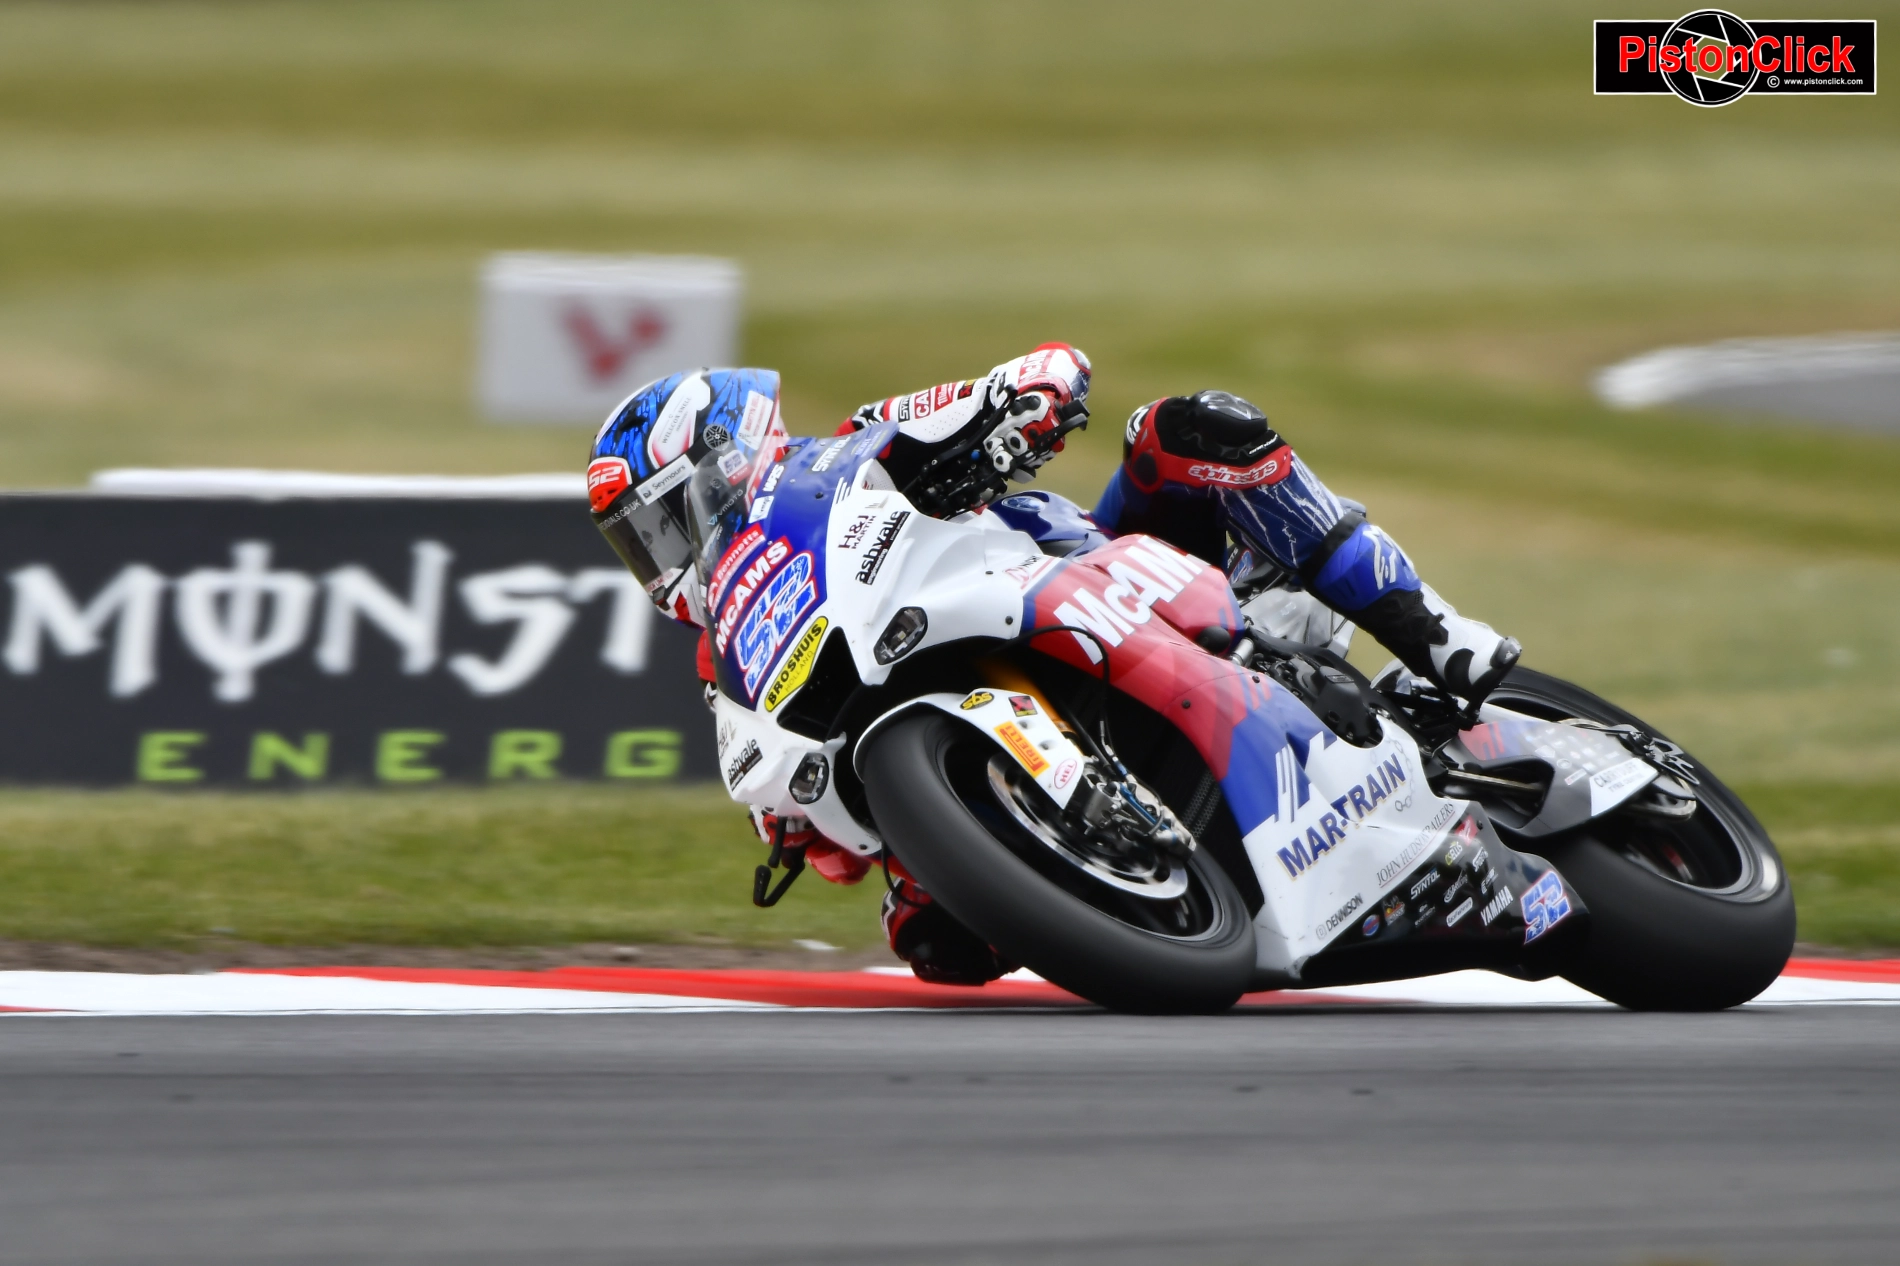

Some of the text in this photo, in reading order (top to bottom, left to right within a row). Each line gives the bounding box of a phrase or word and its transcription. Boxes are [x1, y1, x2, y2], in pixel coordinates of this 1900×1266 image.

[588, 465, 624, 490] 52
[651, 464, 687, 492] Seymours
[1188, 459, 1278, 485] alpinestars
[838, 514, 870, 550] H&J
[851, 514, 877, 550] MARTIN
[855, 509, 900, 583] ashvale
[716, 528, 761, 580] Bennetts
[714, 541, 789, 653] McAMS
[735, 552, 818, 701] 52
[767, 622, 822, 706] BROSHUIS
[784, 650, 815, 693] HOLLAND
[961, 691, 994, 710] sbs
[136, 730, 684, 781] ENERG
[728, 738, 758, 782] ashvale
[999, 725, 1045, 773] PIRELLI
[1376, 859, 1401, 887] JOHN
[1411, 868, 1441, 900] SYNTOL
[1325, 892, 1364, 933] DENNISON
[1480, 885, 1514, 927] YAMAHA
[1520, 870, 1571, 945] 52
